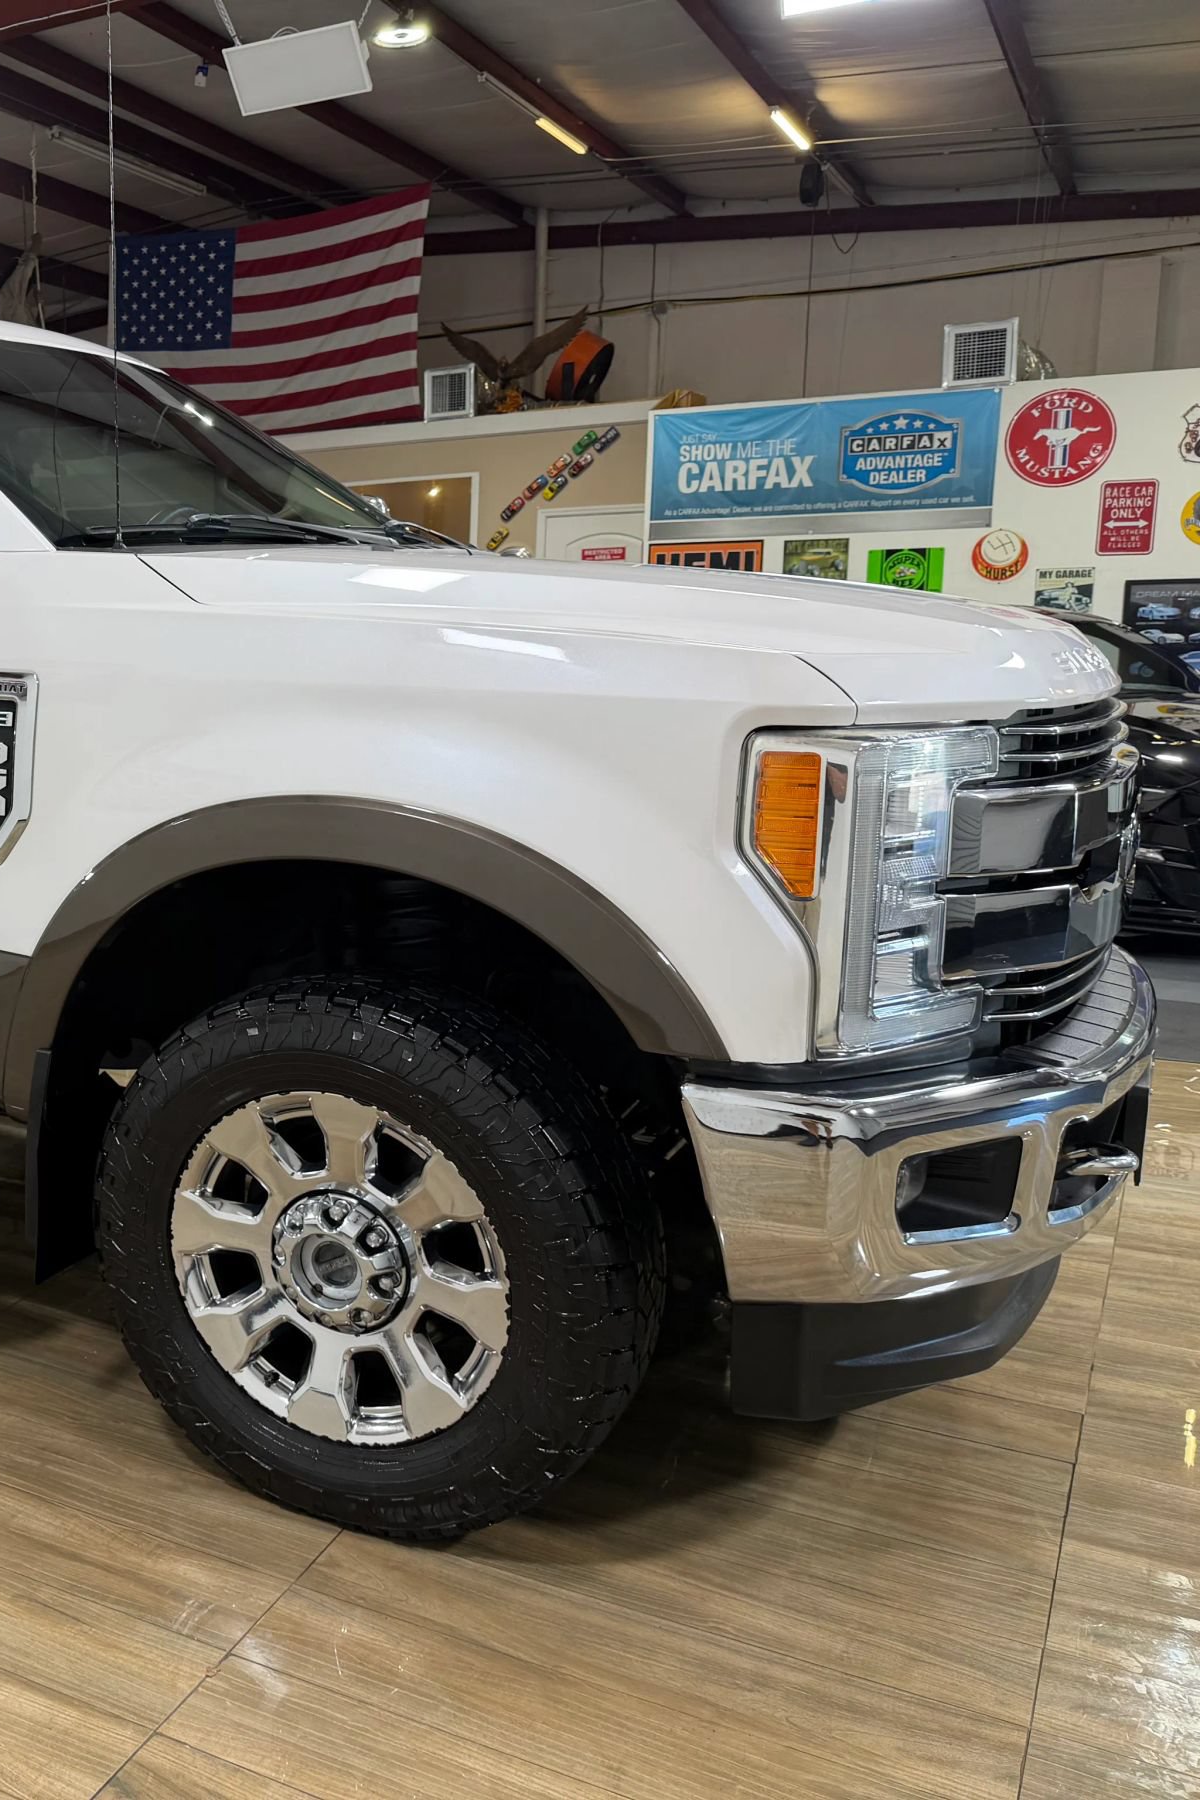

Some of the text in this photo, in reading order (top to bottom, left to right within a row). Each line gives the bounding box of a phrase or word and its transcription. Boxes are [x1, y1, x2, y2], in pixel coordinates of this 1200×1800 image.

[1030, 396, 1094, 417] FORD
[680, 434, 699, 444] JUST
[850, 432, 950, 453] CARFAX
[680, 438, 797, 462] SHOW ME THE
[856, 453, 942, 471] ADVANTAGE
[1016, 443, 1103, 479] MUSTANG
[678, 455, 814, 494] CARFAX
[869, 469, 926, 485] DEALER
[1106, 486, 1154, 498] RACE CAR
[1105, 497, 1152, 508] PARKING
[1110, 507, 1144, 519] ONLY
[986, 560, 1020, 579] HURST
[1039, 569, 1092, 579] MY GARAGE
